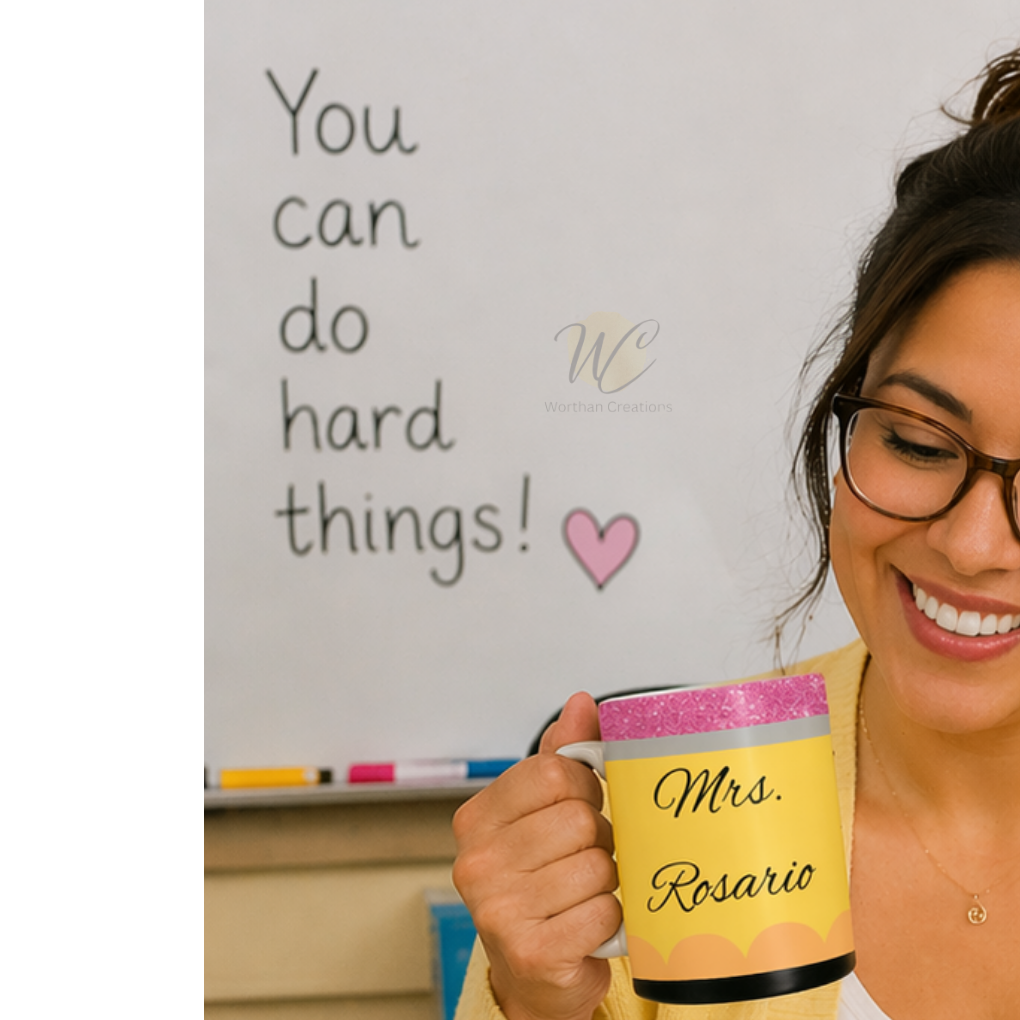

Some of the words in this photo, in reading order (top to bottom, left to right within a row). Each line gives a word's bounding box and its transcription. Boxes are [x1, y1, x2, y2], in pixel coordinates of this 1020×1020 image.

[265, 68, 419, 156] You
[272, 195, 420, 250] can
[279, 277, 370, 354] do
[281, 377, 456, 453] hard
[275, 474, 531, 588] things!
[653, 765, 783, 819] Mrs.
[646, 861, 816, 913] Rosario
